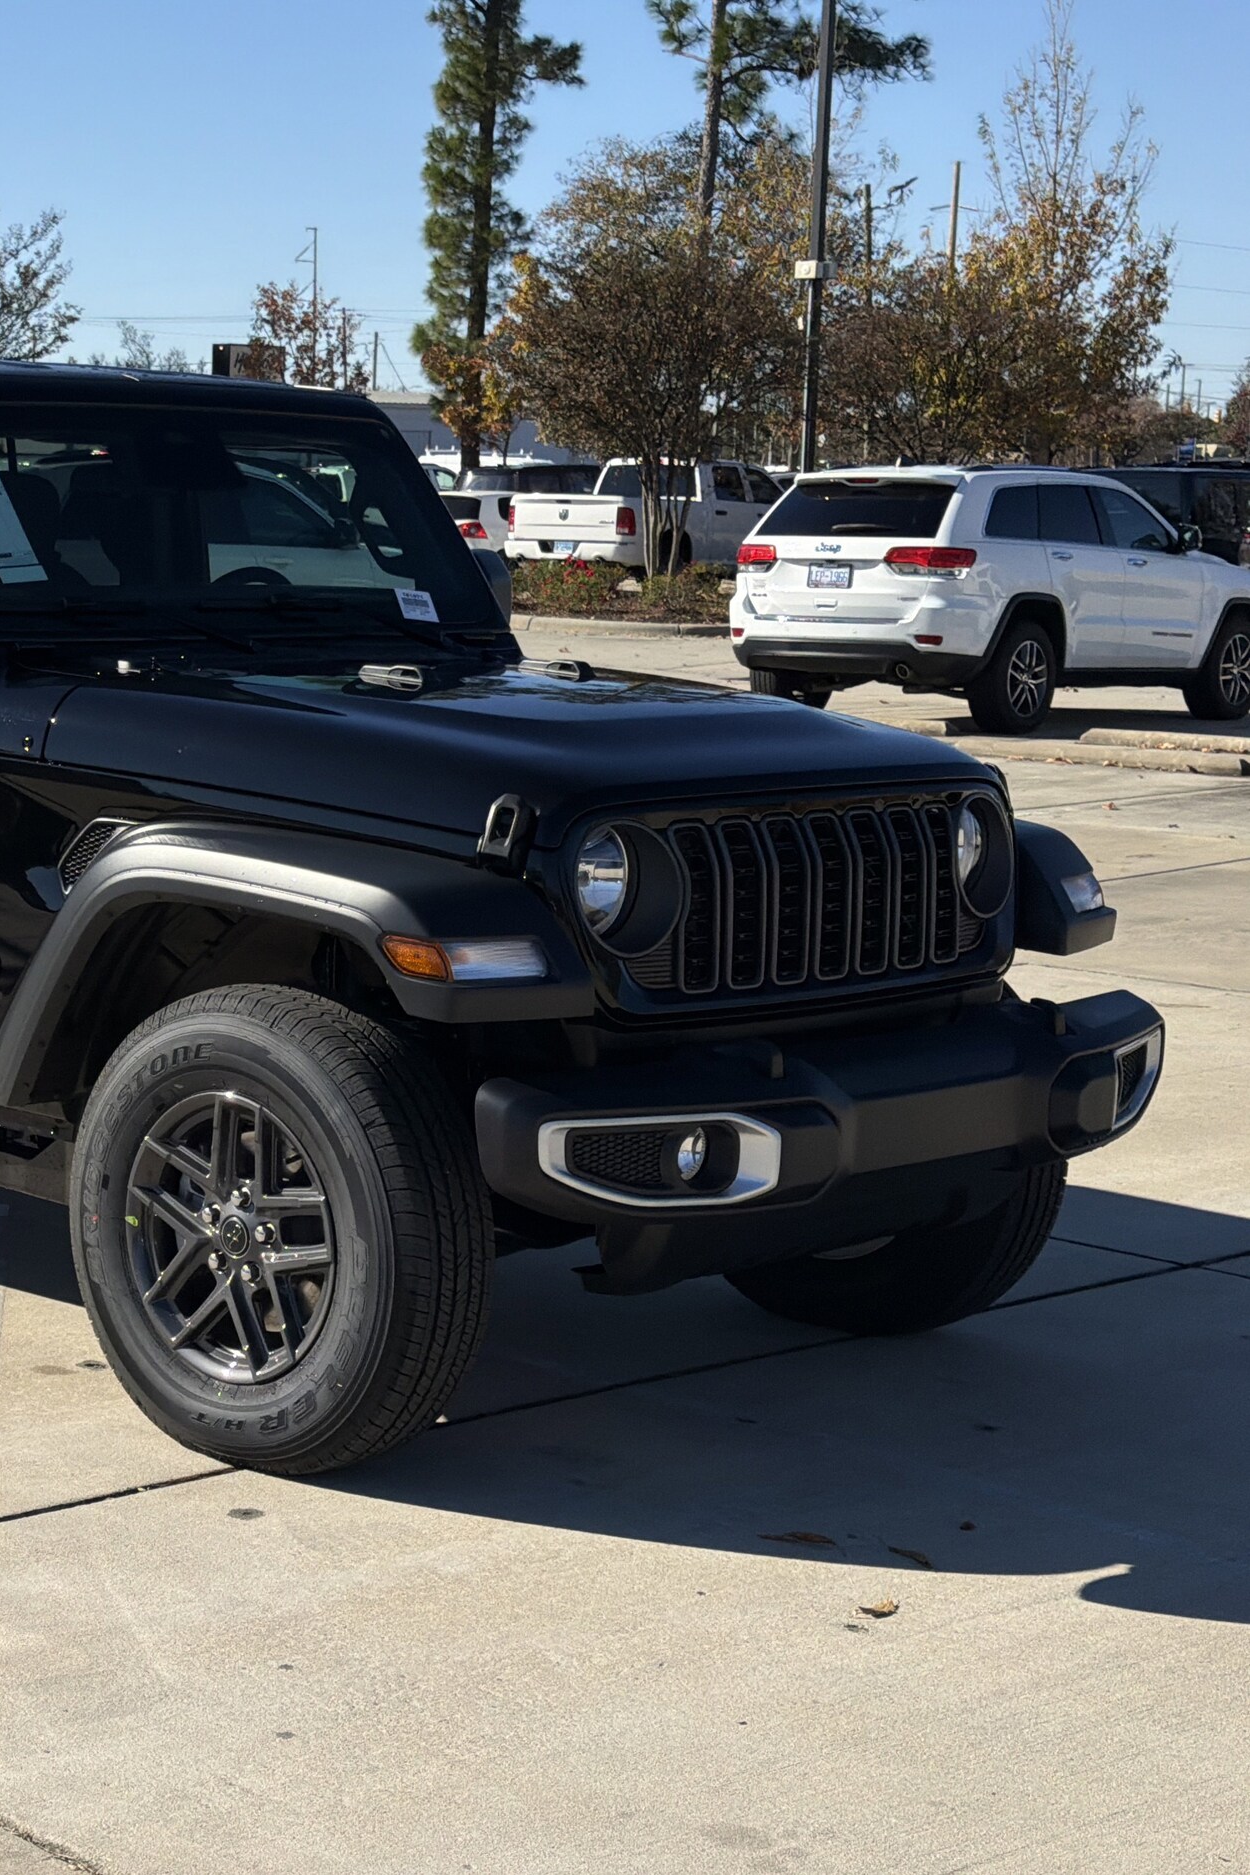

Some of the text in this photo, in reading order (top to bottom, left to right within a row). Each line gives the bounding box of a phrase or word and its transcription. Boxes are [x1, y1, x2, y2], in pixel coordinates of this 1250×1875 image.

[815, 542, 842, 554] Jeep
[83, 1042, 216, 1286] BRIDGESTONE
[191, 1235, 369, 1435] DUELER H/T
